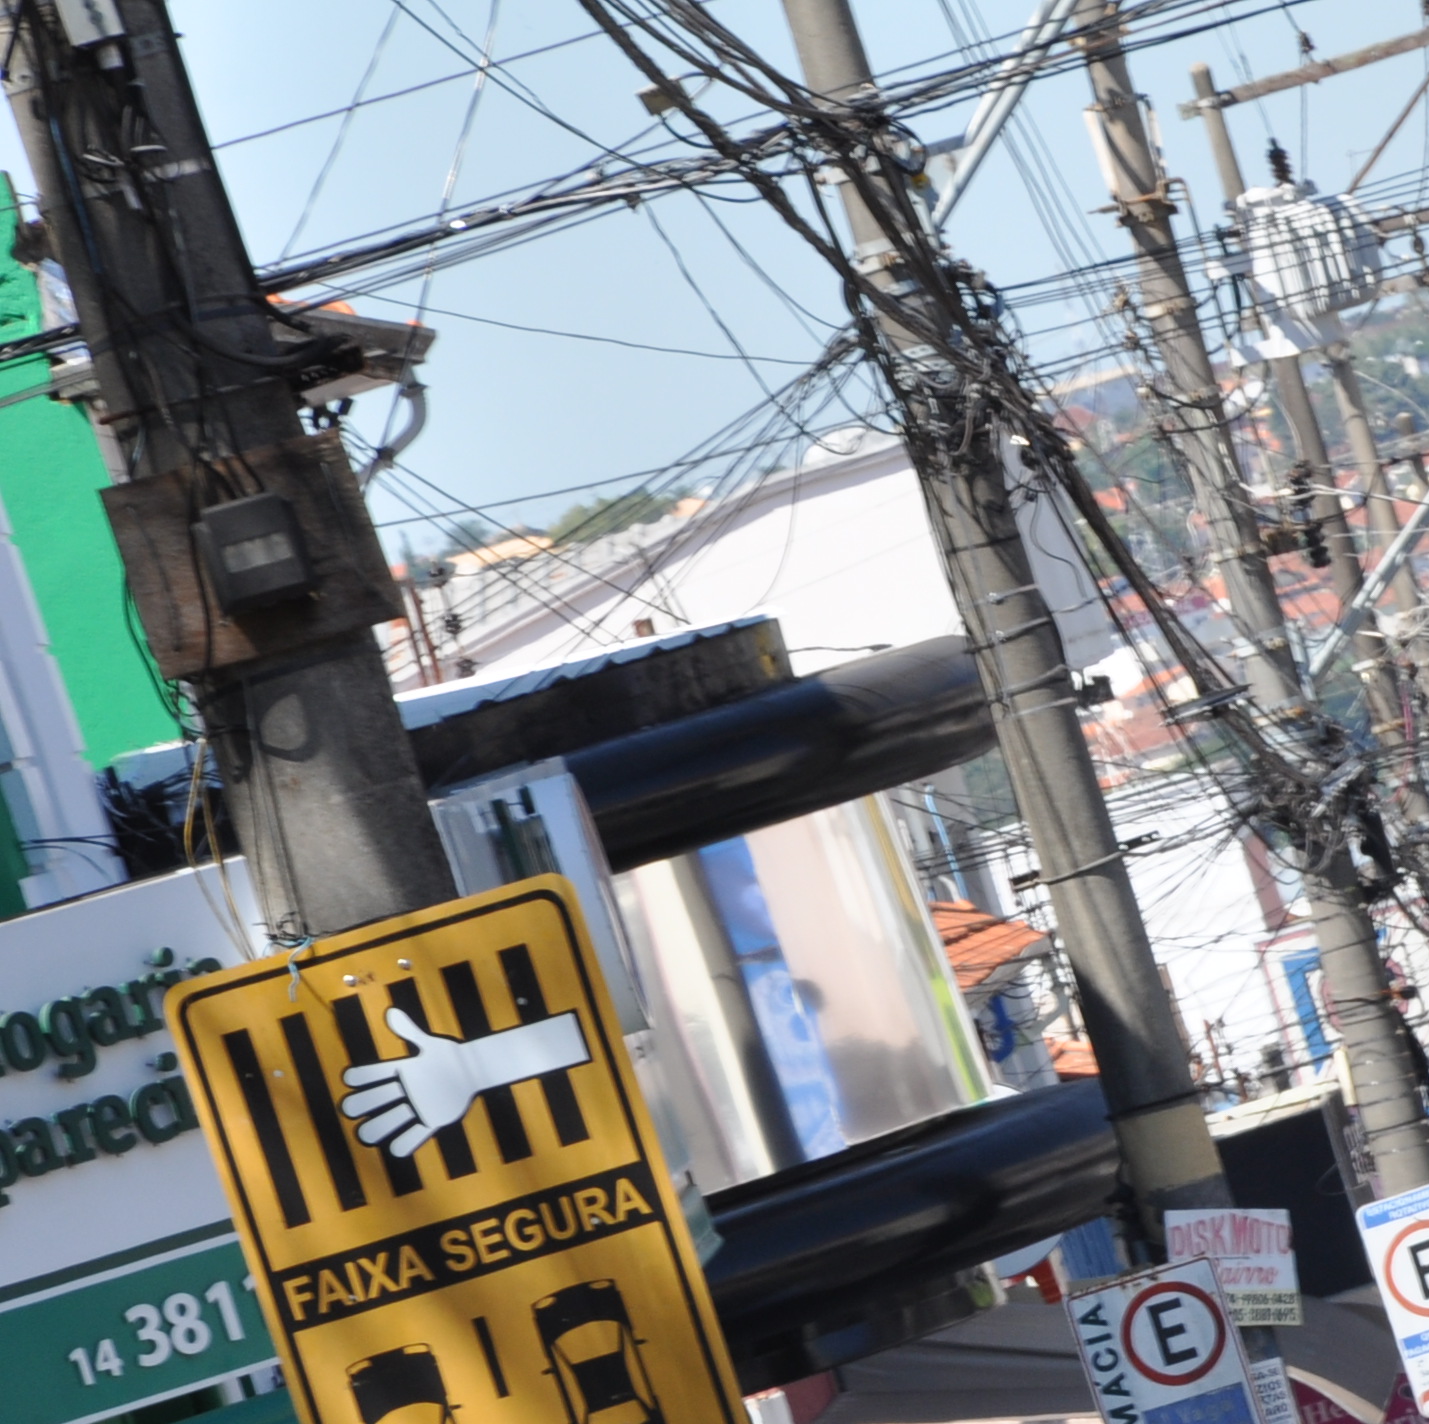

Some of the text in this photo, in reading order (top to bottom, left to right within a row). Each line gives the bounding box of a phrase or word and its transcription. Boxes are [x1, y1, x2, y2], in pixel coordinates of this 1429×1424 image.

[283, 1179, 653, 1322] FAIXA SEGURA
[1168, 1212, 1293, 1257] DISK MOTO
[69, 1273, 262, 1387] 14 381
[1146, 1298, 1199, 1367] E
